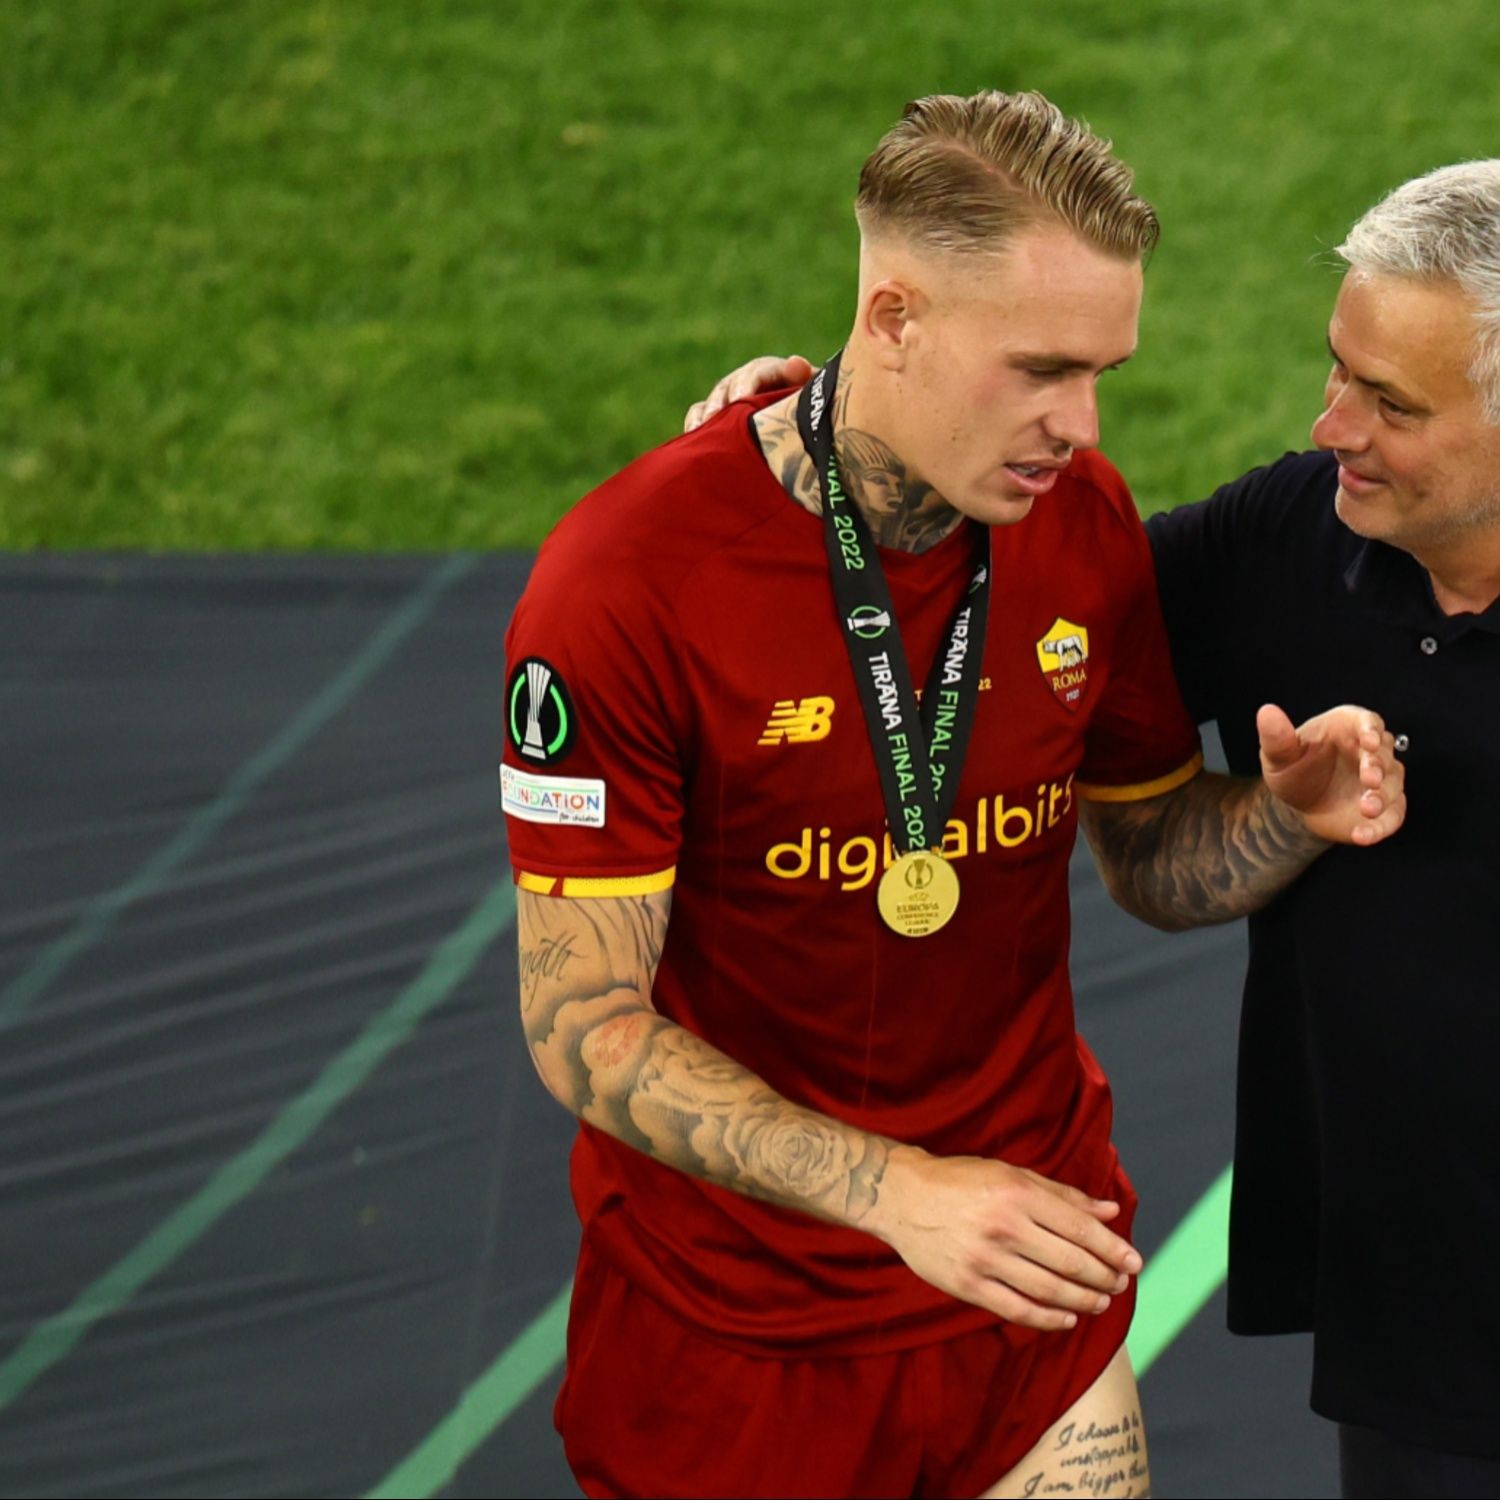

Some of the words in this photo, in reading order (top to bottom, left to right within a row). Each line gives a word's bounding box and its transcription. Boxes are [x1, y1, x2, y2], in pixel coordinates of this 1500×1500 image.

[810, 369, 827, 438] TIRAN
[834, 515, 865, 571] 2022
[929, 690, 959, 758] FINAL
[1052, 668, 1087, 692] ROMA
[765, 772, 1074, 891] digialbits
[888, 733, 917, 801] FINAL
[903, 805, 926, 849] 202
